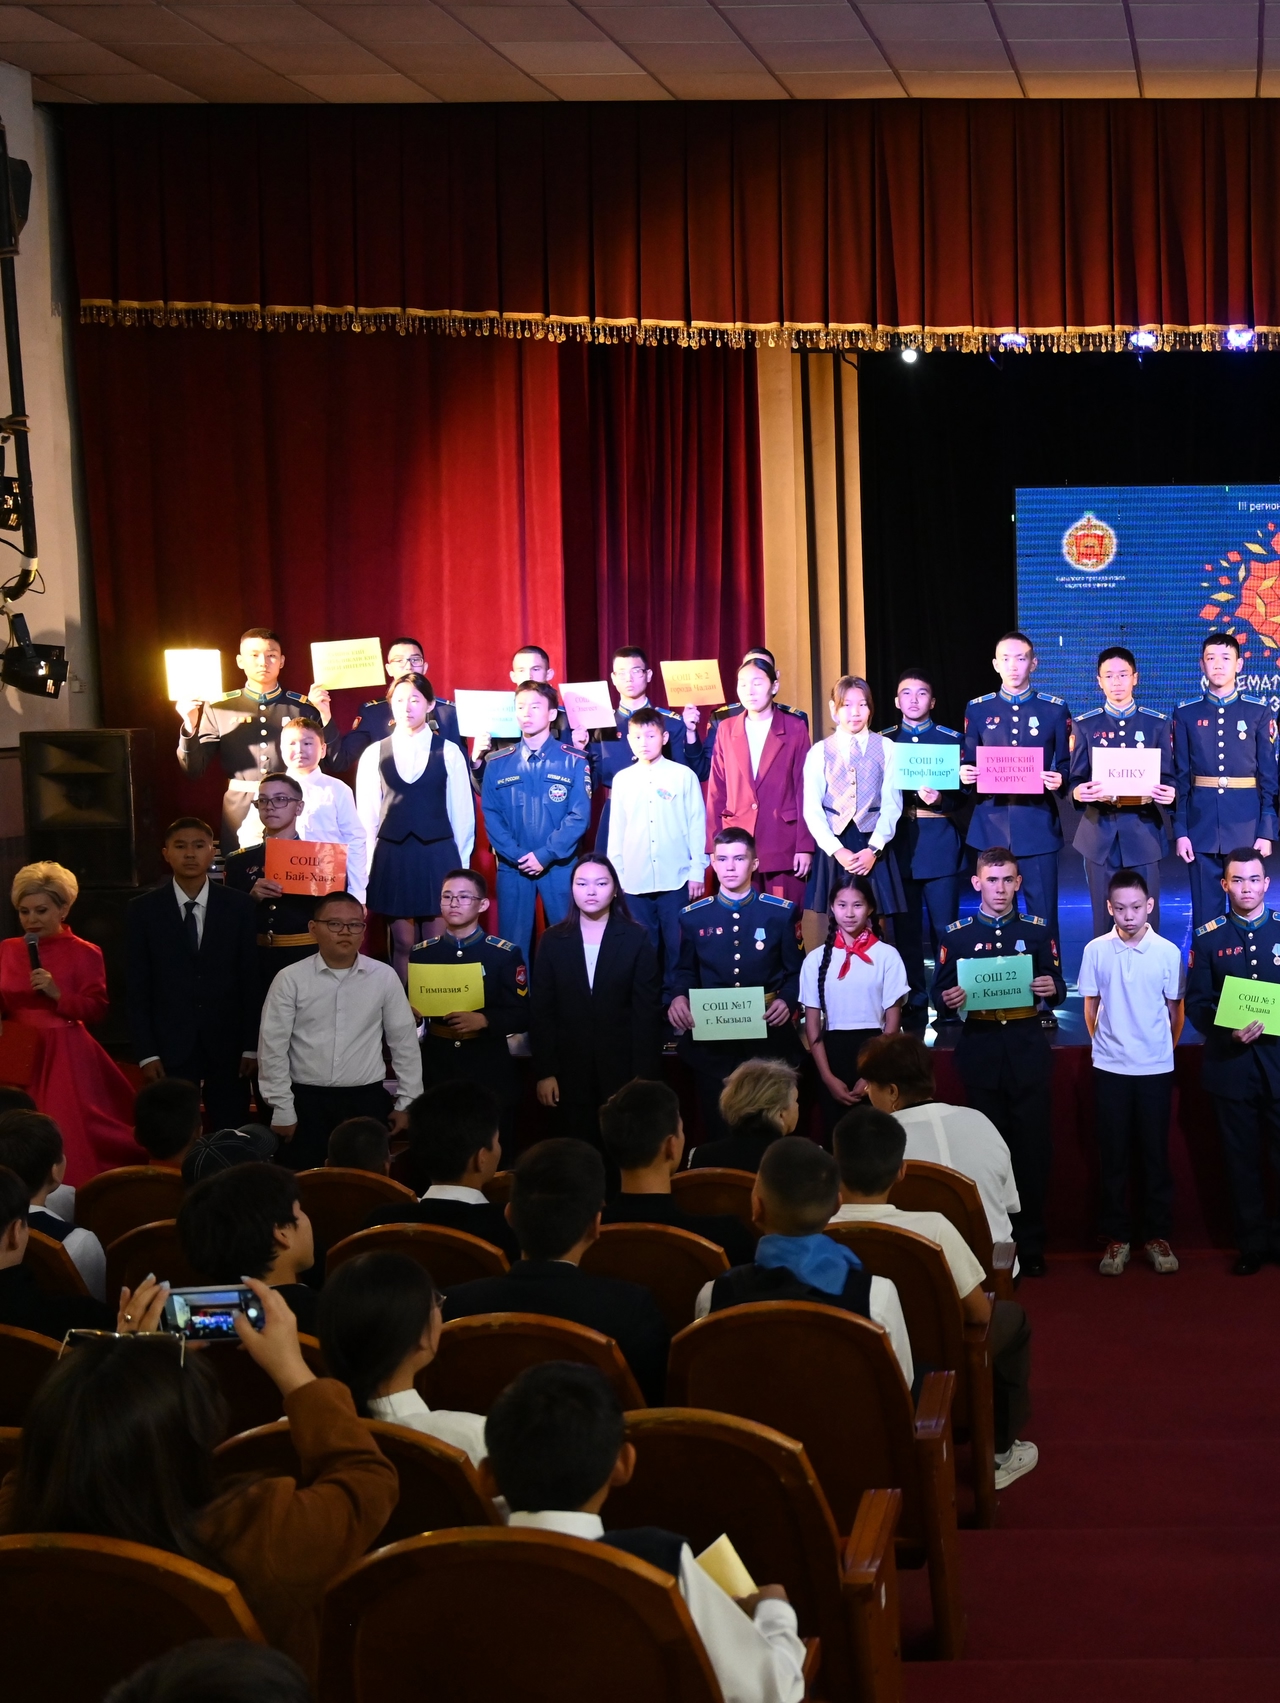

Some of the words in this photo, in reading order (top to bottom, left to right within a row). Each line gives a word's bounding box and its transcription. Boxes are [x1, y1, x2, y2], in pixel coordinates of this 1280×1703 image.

[670, 686, 692, 694] города
[908, 756, 932, 765] СОШ
[935, 757, 944, 765] 19
[985, 755, 1035, 764] ТУВИНСКИЙ
[899, 768, 955, 778] "ПрофЛидер"
[986, 765, 1035, 774] КАДЕТСКИЙ
[1108, 768, 1146, 779] КзПКУ
[290, 855, 320, 867] СОШ
[285, 871, 336, 883] Бай-Хаак
[974, 972, 1003, 984] СОШ
[1005, 970, 1018, 981] 22
[419, 985, 462, 994] Гимназия
[464, 984, 470, 993] 5
[983, 987, 1022, 998] Кызыла
[1238, 993, 1260, 1004] СОШ
[702, 1002, 728, 1012] СОШ
[730, 1000, 753, 1010] №17
[715, 1015, 752, 1025] Кызыла
